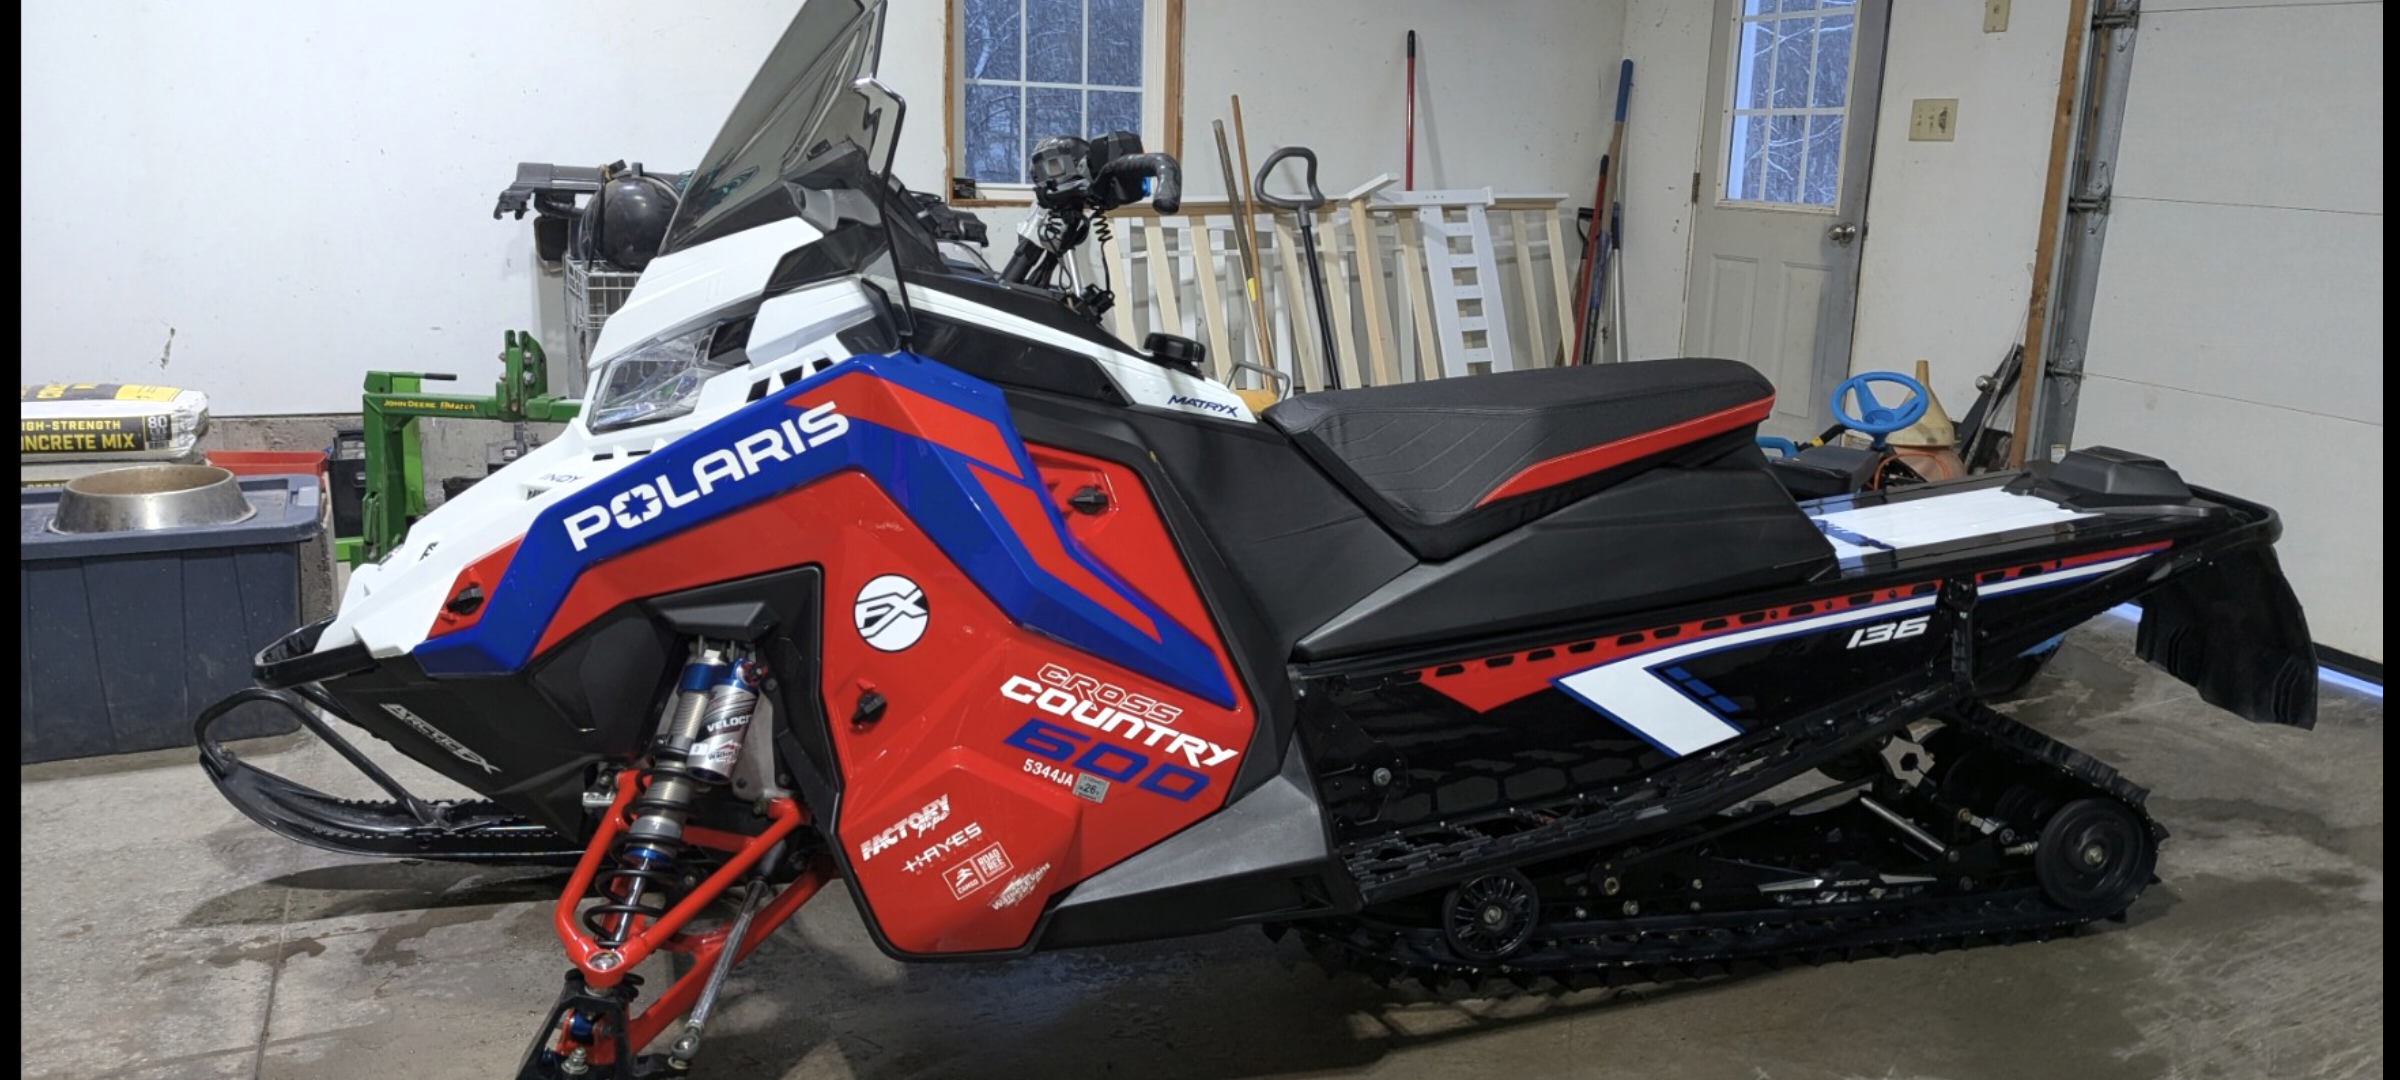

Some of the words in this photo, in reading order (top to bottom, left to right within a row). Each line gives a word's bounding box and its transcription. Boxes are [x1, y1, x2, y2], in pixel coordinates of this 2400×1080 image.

[148, 416, 168, 429] 80
[1168, 394, 1239, 418] MATRYX
[102, 432, 135, 449] MIX
[563, 401, 850, 552] POLARIS
[1846, 615, 1931, 650] 136
[1037, 663, 1183, 724] CROSS
[1000, 675, 1239, 768] COUNTRY
[1003, 718, 1210, 802] 600
[1023, 758, 1073, 787] 5344JA
[859, 793, 950, 862] FACTORY
[901, 821, 982, 873] HAYES
